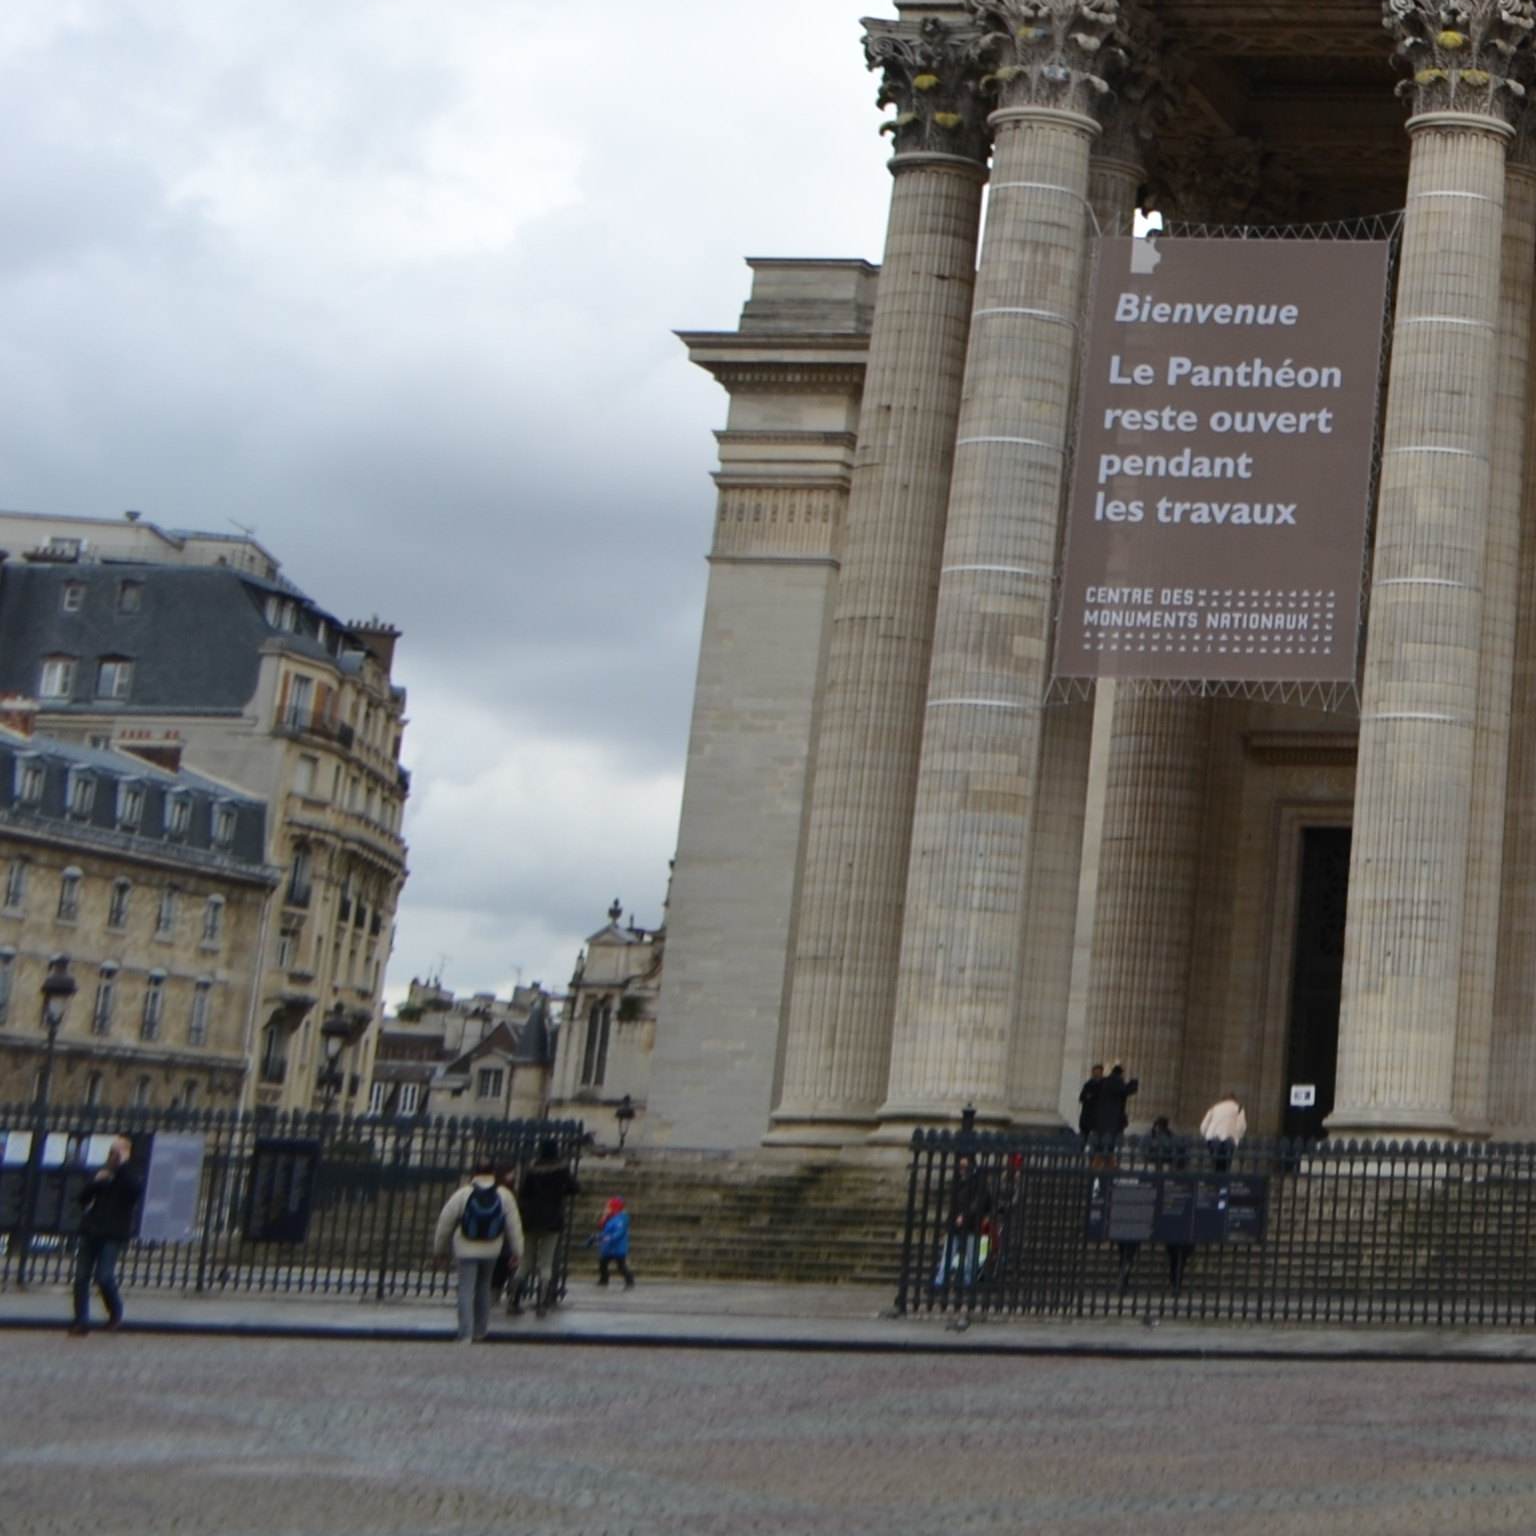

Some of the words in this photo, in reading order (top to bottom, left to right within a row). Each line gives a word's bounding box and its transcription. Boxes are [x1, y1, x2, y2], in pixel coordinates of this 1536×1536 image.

[1115, 293, 1298, 325] Bienvenue
[1110, 355, 1154, 385] Le
[1168, 357, 1341, 387] Panthéon
[1104, 406, 1197, 431] reste
[1210, 408, 1333, 433] ouvert
[1099, 448, 1252, 483] pendant
[1095, 492, 1144, 522] les
[1157, 497, 1296, 524] travaux
[1086, 587, 1153, 604] CENTRE
[1161, 589, 1193, 605] DES
[1084, 609, 1197, 628] MONUMENTS
[1206, 613, 1308, 629] NATIONAUX
